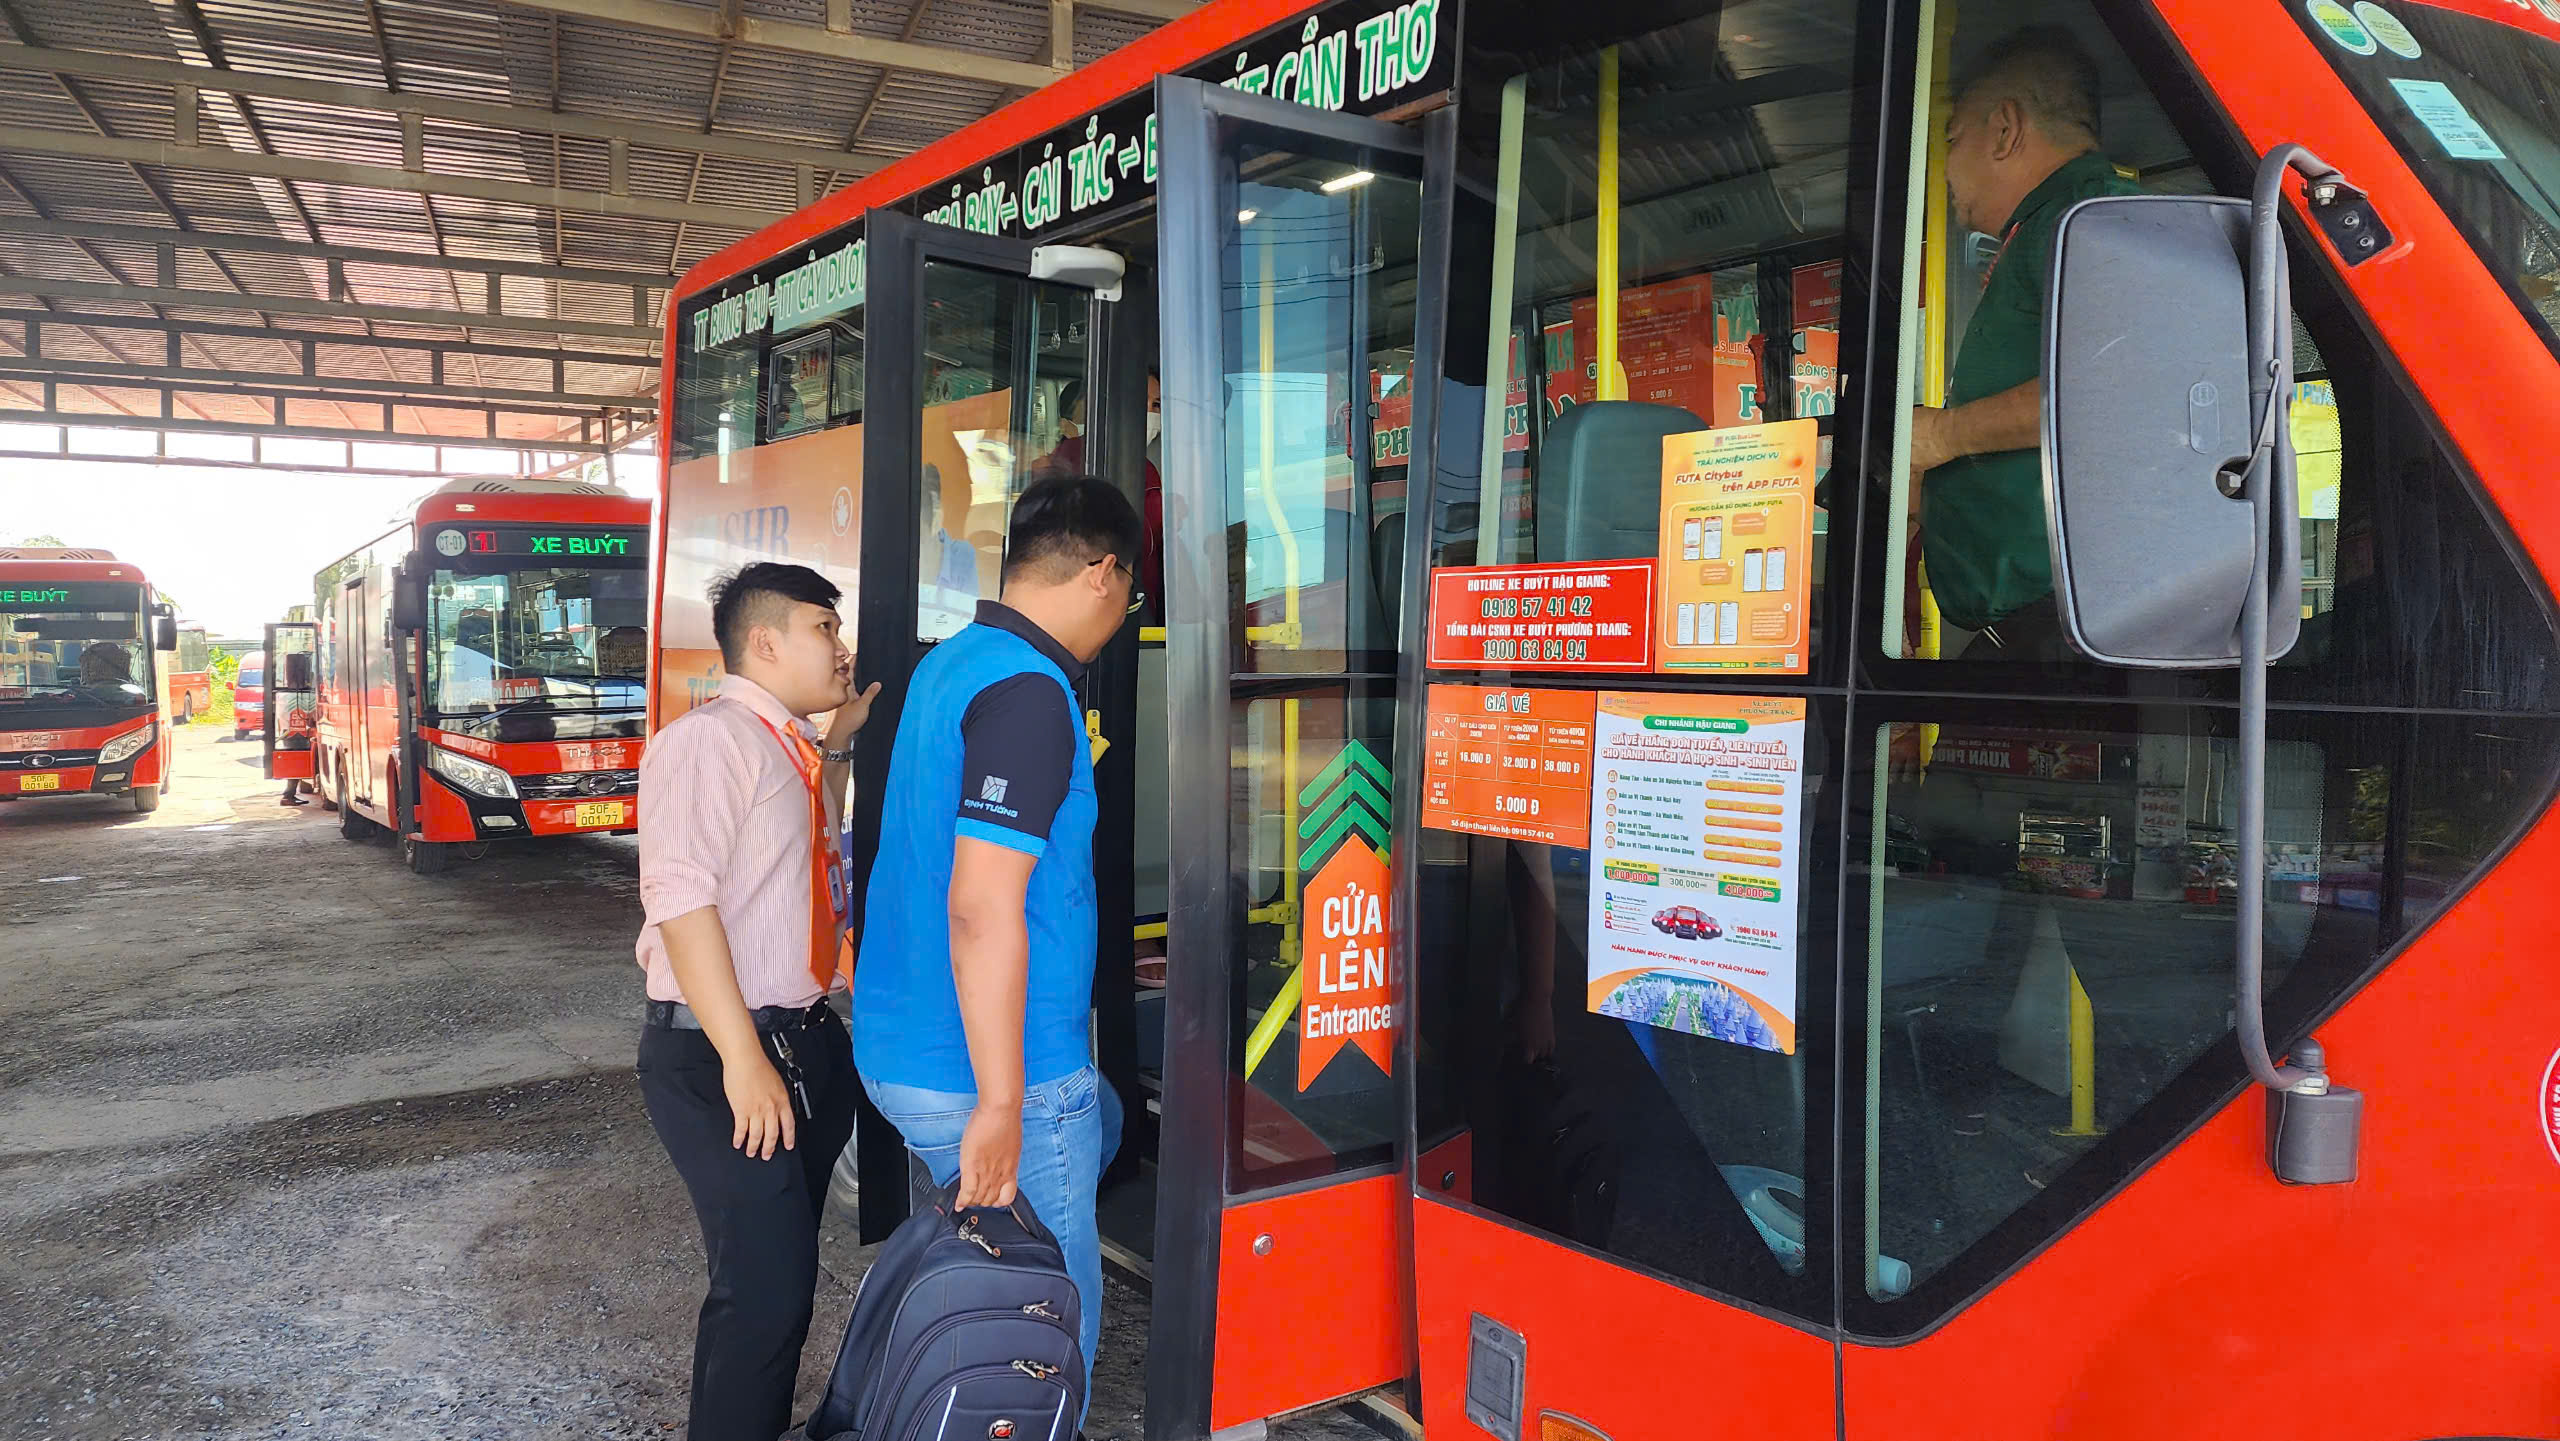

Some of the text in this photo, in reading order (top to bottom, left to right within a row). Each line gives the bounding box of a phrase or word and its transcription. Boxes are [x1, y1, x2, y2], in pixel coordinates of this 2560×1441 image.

[694, 308, 709, 353] TT
[709, 288, 744, 347] BÚNG
[745, 274, 770, 334] TÀU
[778, 270, 795, 320] TT
[798, 249, 824, 312] CÂY
[965, 166, 1006, 236] BẢY
[1023, 142, 1062, 230] CÁI
[1068, 115, 1116, 212] TẮC
[1272, 15, 1347, 111] CẦN
[1355, 0, 1440, 101] THƠ
[1796, 362, 1828, 379] CÔNG
[1675, 470, 1743, 484] FUTA Citybus
[1722, 477, 1800, 492] trên APP FUTA
[474, 533, 488, 551] 1
[531, 533, 628, 554] XE BUÝT
[1468, 574, 1611, 591] HOTLINE XE BUÝT HẬU GIANG:
[21, 588, 69, 602] BUÝT
[1482, 596, 1592, 618] 0918 57 41 42
[1447, 620, 1632, 637] TỔNG ĐÀI CSKH XE BUÝT PHƯƠNG TRANG:
[1482, 640, 1587, 660] 1900 63 84 94
[688, 664, 721, 710] TIẾ
[1485, 692, 1531, 713] GIÁ VÉ
[1654, 718, 1736, 730] CHI NHÁNH HẬU GIANG
[1611, 732, 1626, 746] GIÁ
[1626, 732, 1640, 746] VÉ
[1640, 734, 1670, 748] THÁNG
[567, 746, 626, 759] THACO
[1601, 747, 1619, 759] CHO
[1620, 747, 1645, 761] HÀNH
[1645, 749, 1677, 763] KHÁCH
[1679, 751, 1692, 764] VÀ
[1693, 753, 1714, 767] HỌC
[1715, 755, 1738, 767] SINH
[1746, 757, 1770, 769] SINH
[1772, 757, 1797, 772] VIÊN
[1503, 756, 1529, 769] 32.000
[589, 804, 609, 815] 50F
[1495, 796, 1539, 815] 5.000 Đ
[581, 814, 618, 827] 001.77
[1512, 827, 1526, 836] 0918
[1545, 831, 1555, 840] 42
[1322, 881, 1383, 938] CỬA
[1319, 939, 1384, 994] LÊN
[1306, 1002, 1392, 1039] Entrance
